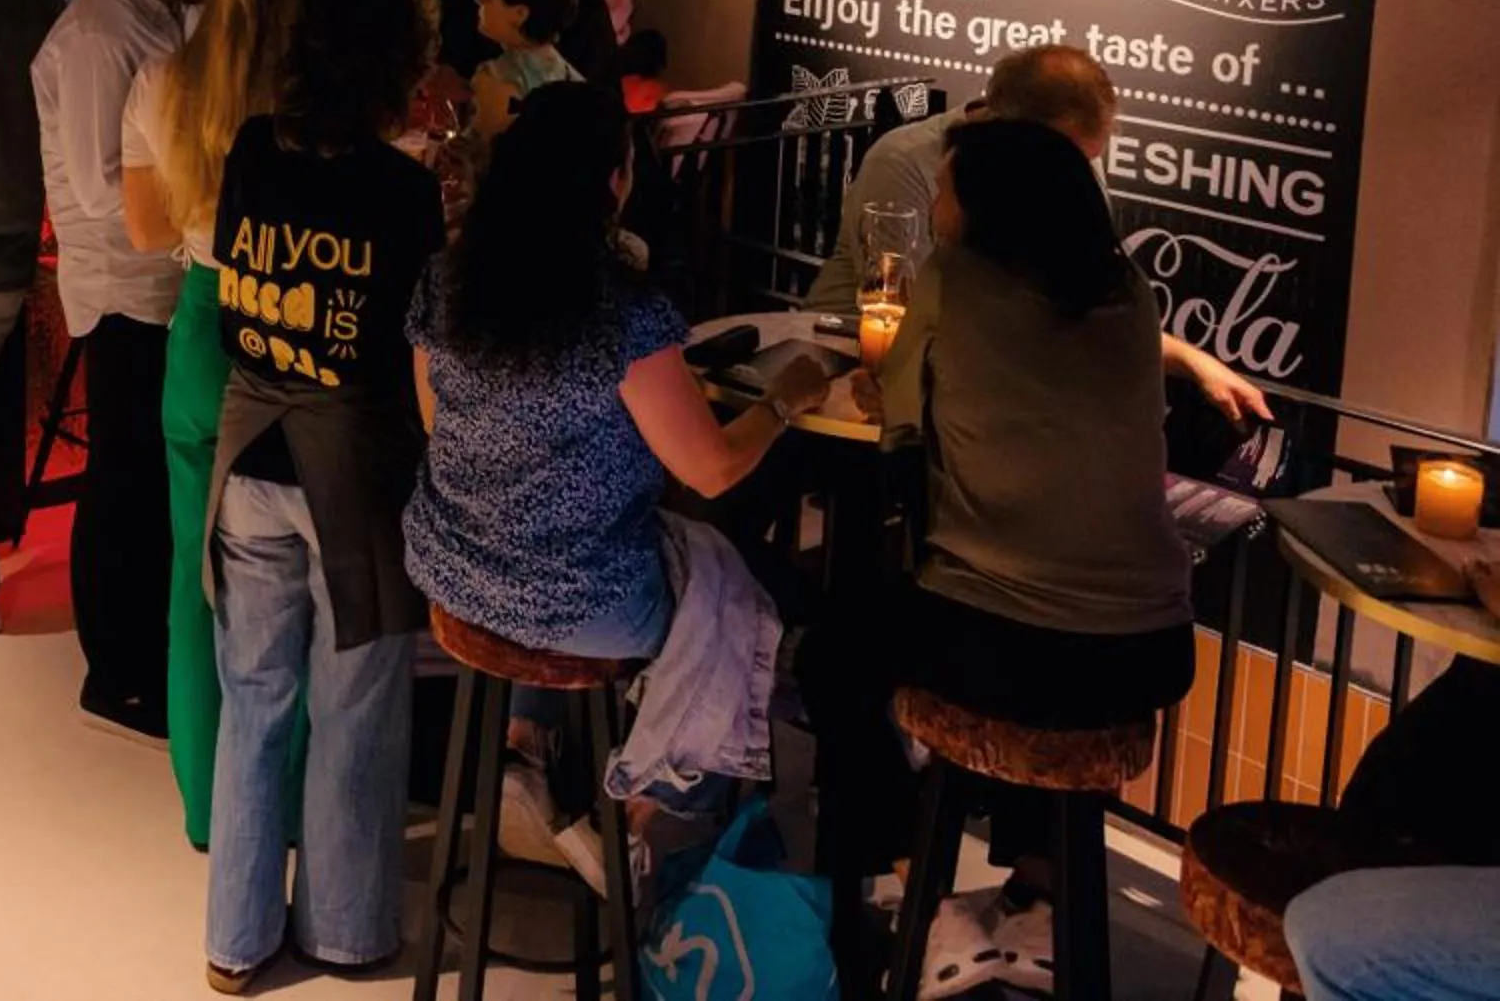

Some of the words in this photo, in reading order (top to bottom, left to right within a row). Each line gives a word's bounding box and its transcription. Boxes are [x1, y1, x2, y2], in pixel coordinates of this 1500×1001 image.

[966, 18, 1067, 56] great
[1085, 23, 1195, 76] taste
[1211, 43, 1261, 86] of
[1107, 135, 1326, 216] ESHING
[231, 216, 276, 275] All
[281, 222, 372, 277] you
[219, 265, 315, 332] need
[324, 299, 358, 340] is
